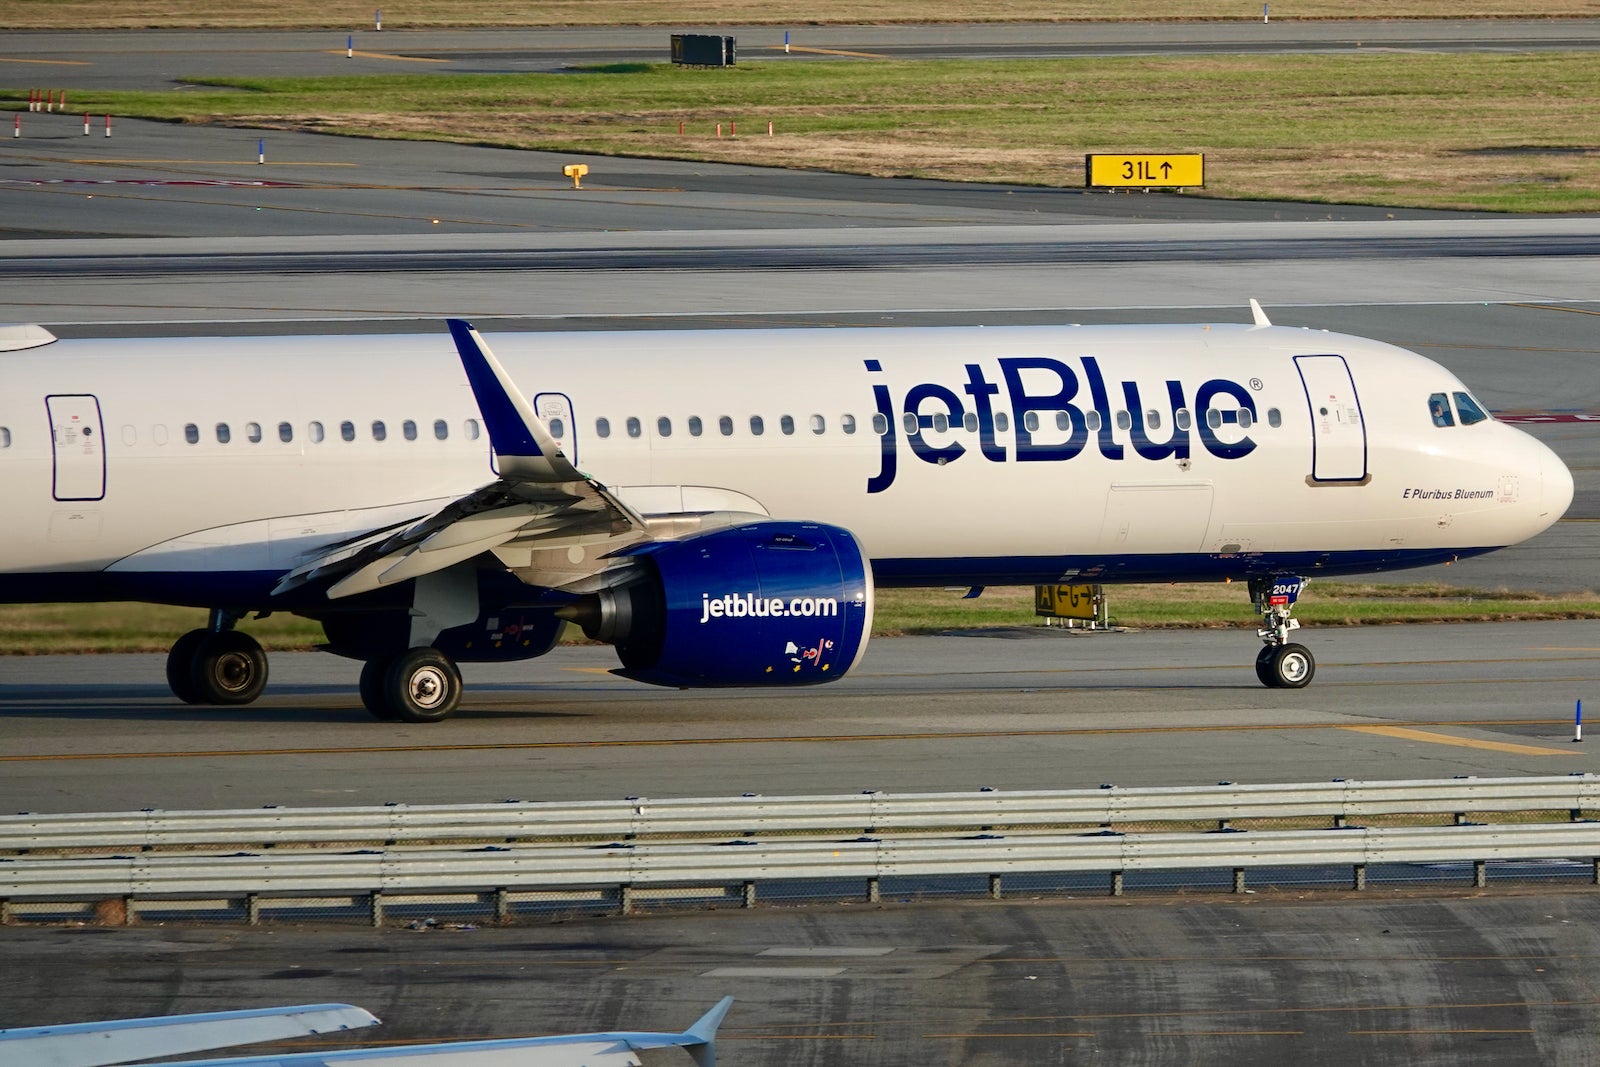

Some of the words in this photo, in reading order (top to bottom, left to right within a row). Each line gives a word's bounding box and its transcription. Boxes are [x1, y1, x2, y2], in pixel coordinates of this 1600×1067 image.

[1122, 161, 1156, 180] 31L
[863, 356, 1258, 494] jetBlue
[1402, 488, 1411, 499] E
[1411, 488, 1453, 500] Pluribus
[1453, 488, 1494, 500] Bluenum
[1272, 584, 1299, 595] 2047
[700, 593, 838, 624] jetblue.com
